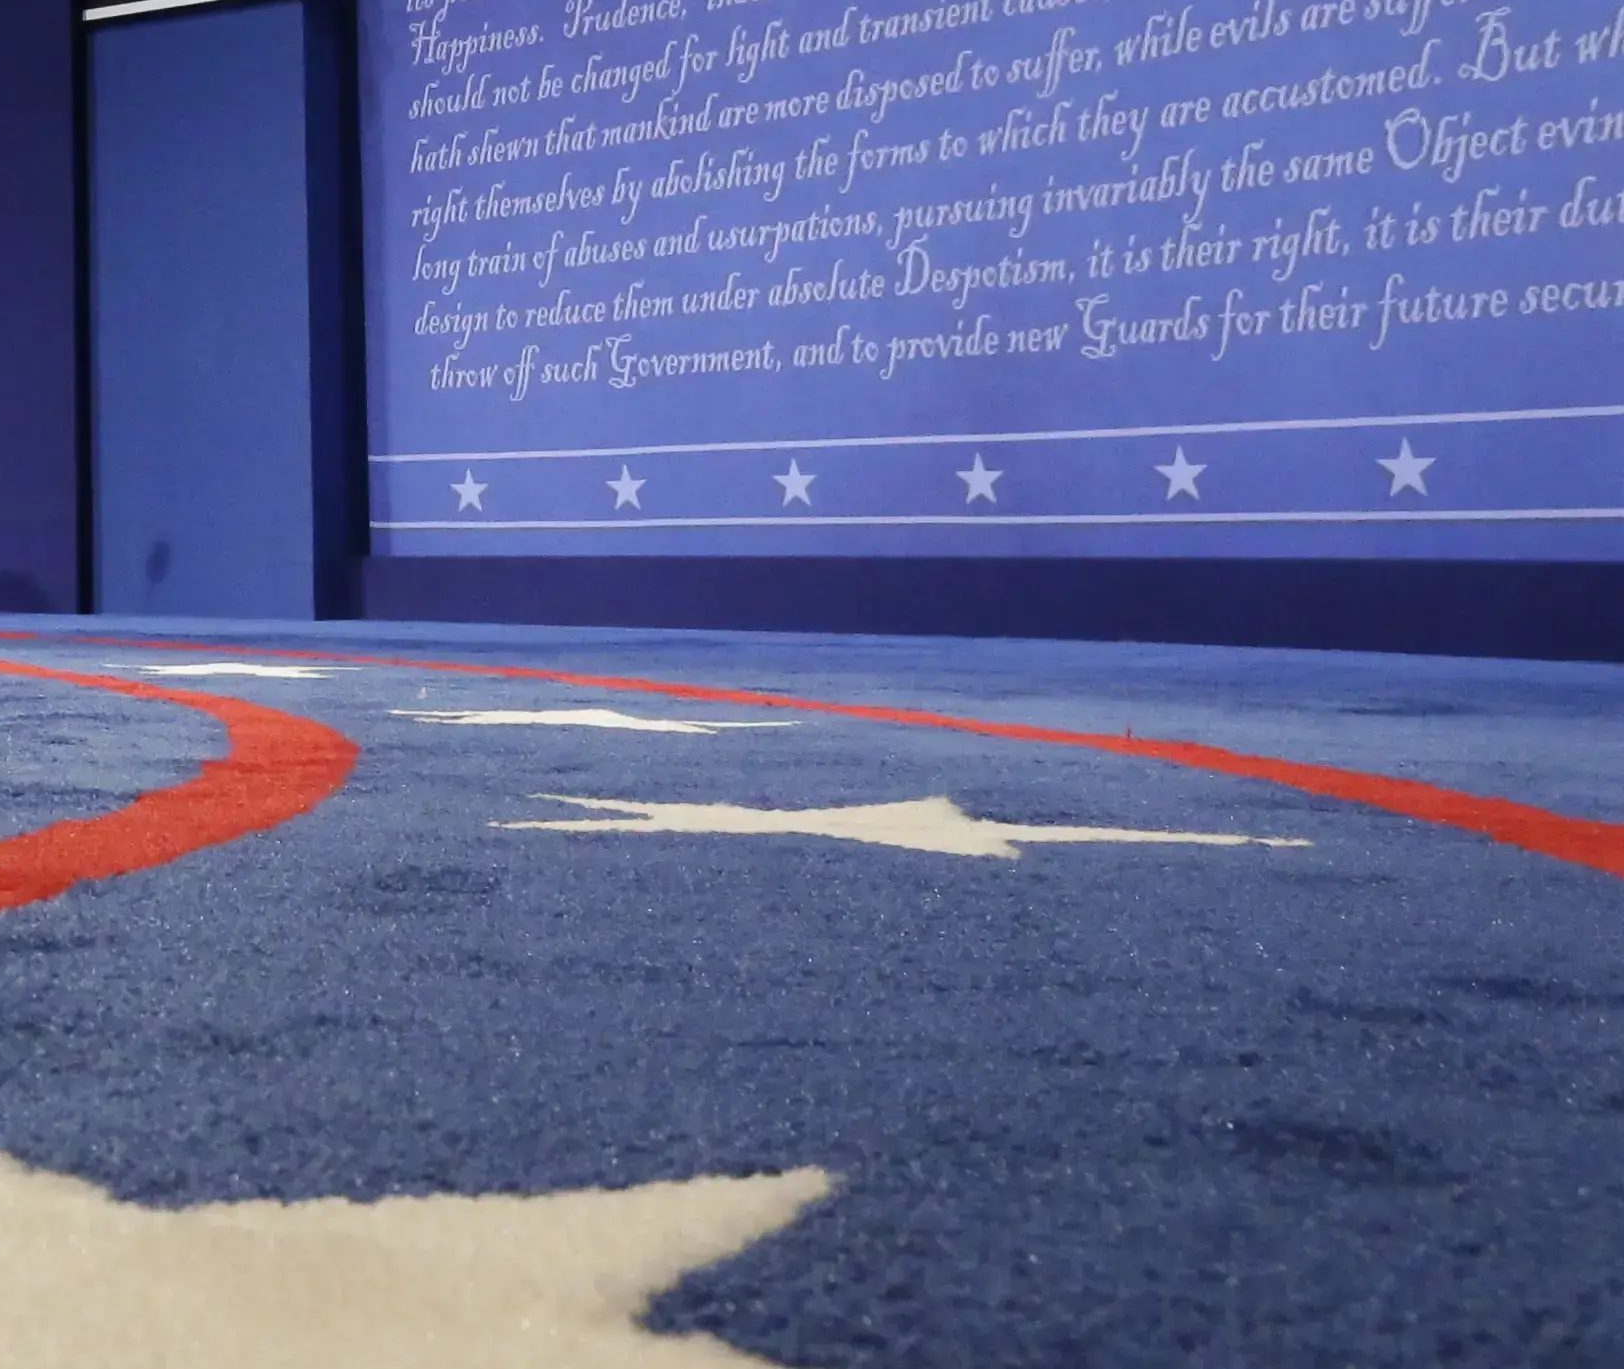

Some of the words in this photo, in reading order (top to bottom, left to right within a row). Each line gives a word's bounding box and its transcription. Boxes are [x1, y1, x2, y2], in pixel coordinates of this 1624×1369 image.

[408, 20, 544, 76] Happiness.
[415, 300, 488, 351] design
[496, 303, 518, 331] to
[525, 288, 606, 328] reduce
[613, 279, 673, 322] them
[682, 271, 760, 315] under
[768, 258, 885, 307] absolute
[895, 233, 1075, 310] Despotism,
[1087, 238, 1114, 279] it
[1123, 234, 1152, 275] is
[1161, 223, 1242, 272] their
[1252, 204, 1350, 283] right,
[1364, 206, 1396, 251] it
[1405, 201, 1441, 246] is
[1450, 184, 1549, 243] their
[430, 351, 498, 391] throw
[503, 344, 540, 402] off
[541, 342, 602, 384] such
[605, 333, 781, 390] Government,
[793, 323, 851, 368] and
[851, 333, 878, 365] to
[879, 313, 999, 381] provide
[1007, 322, 1069, 354] new
[1075, 292, 1210, 360] Guards
[1211, 287, 1271, 362] for
[1279, 280, 1368, 334] their
[1369, 272, 1508, 351] future
